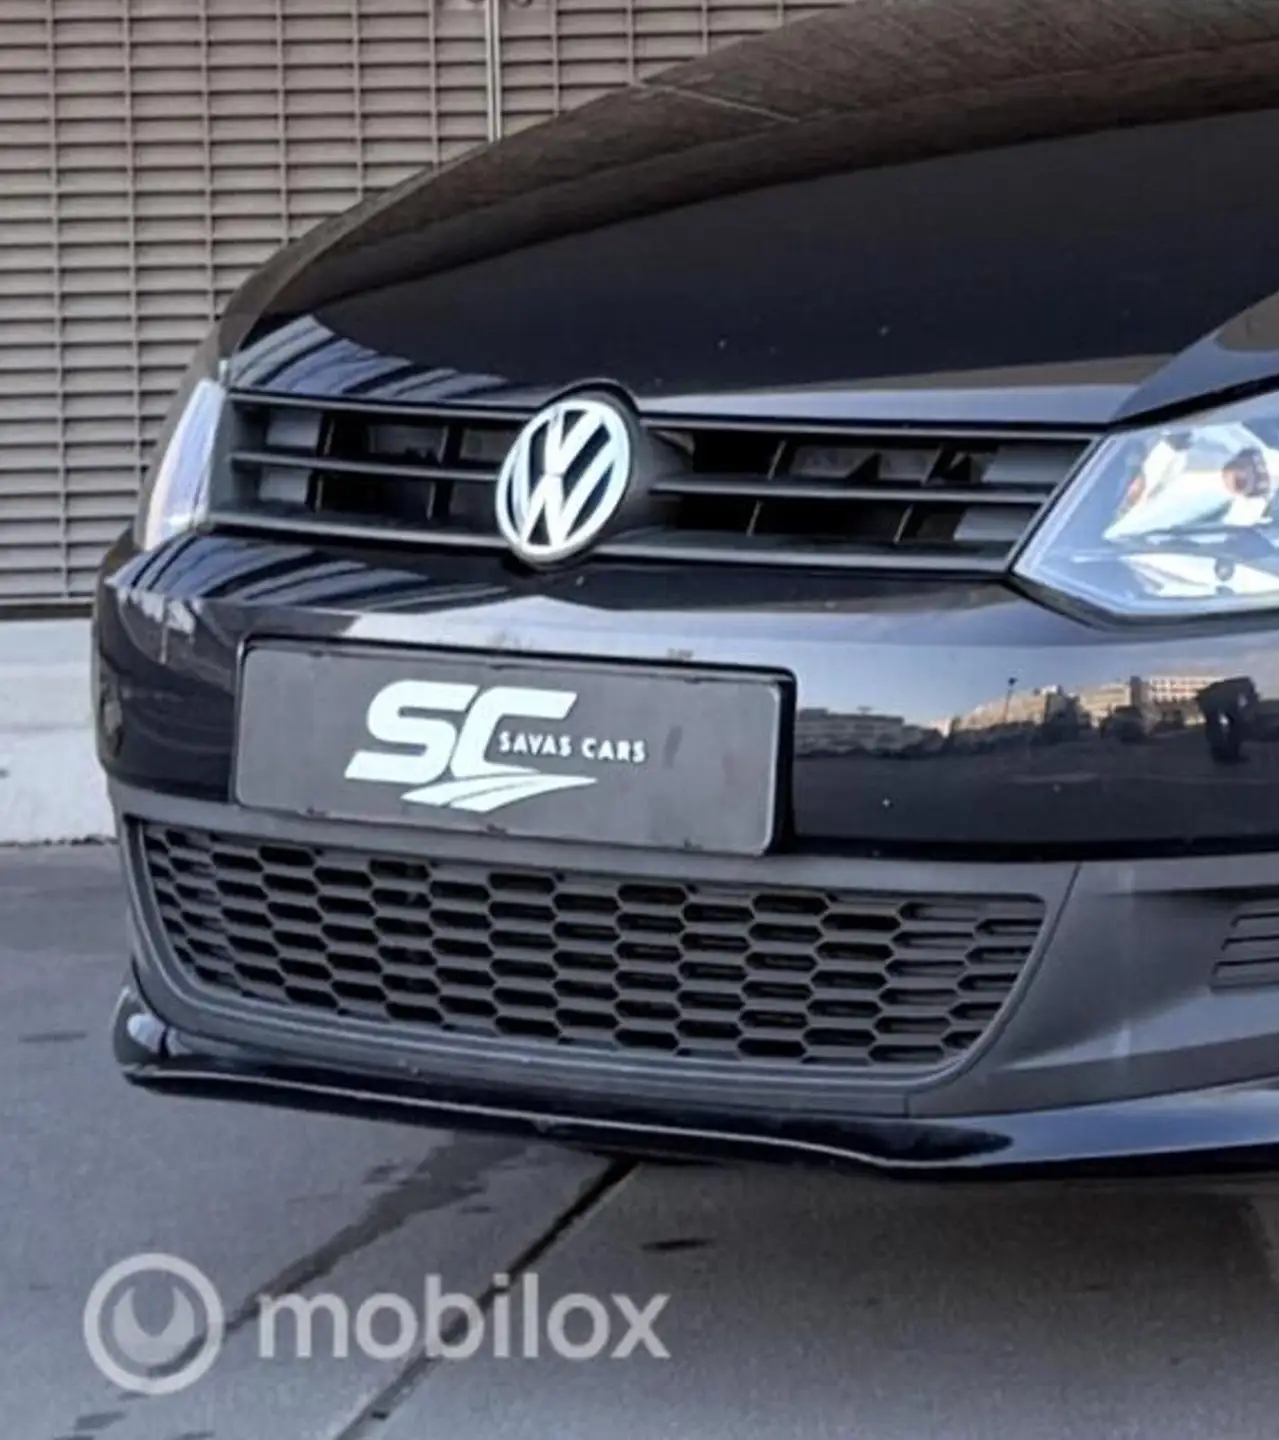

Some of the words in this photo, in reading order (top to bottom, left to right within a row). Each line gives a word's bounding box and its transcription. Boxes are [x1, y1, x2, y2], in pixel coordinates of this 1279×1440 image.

[344, 680, 579, 785] SC
[499, 731, 572, 757] SAVAS
[581, 737, 646, 763] CARS
